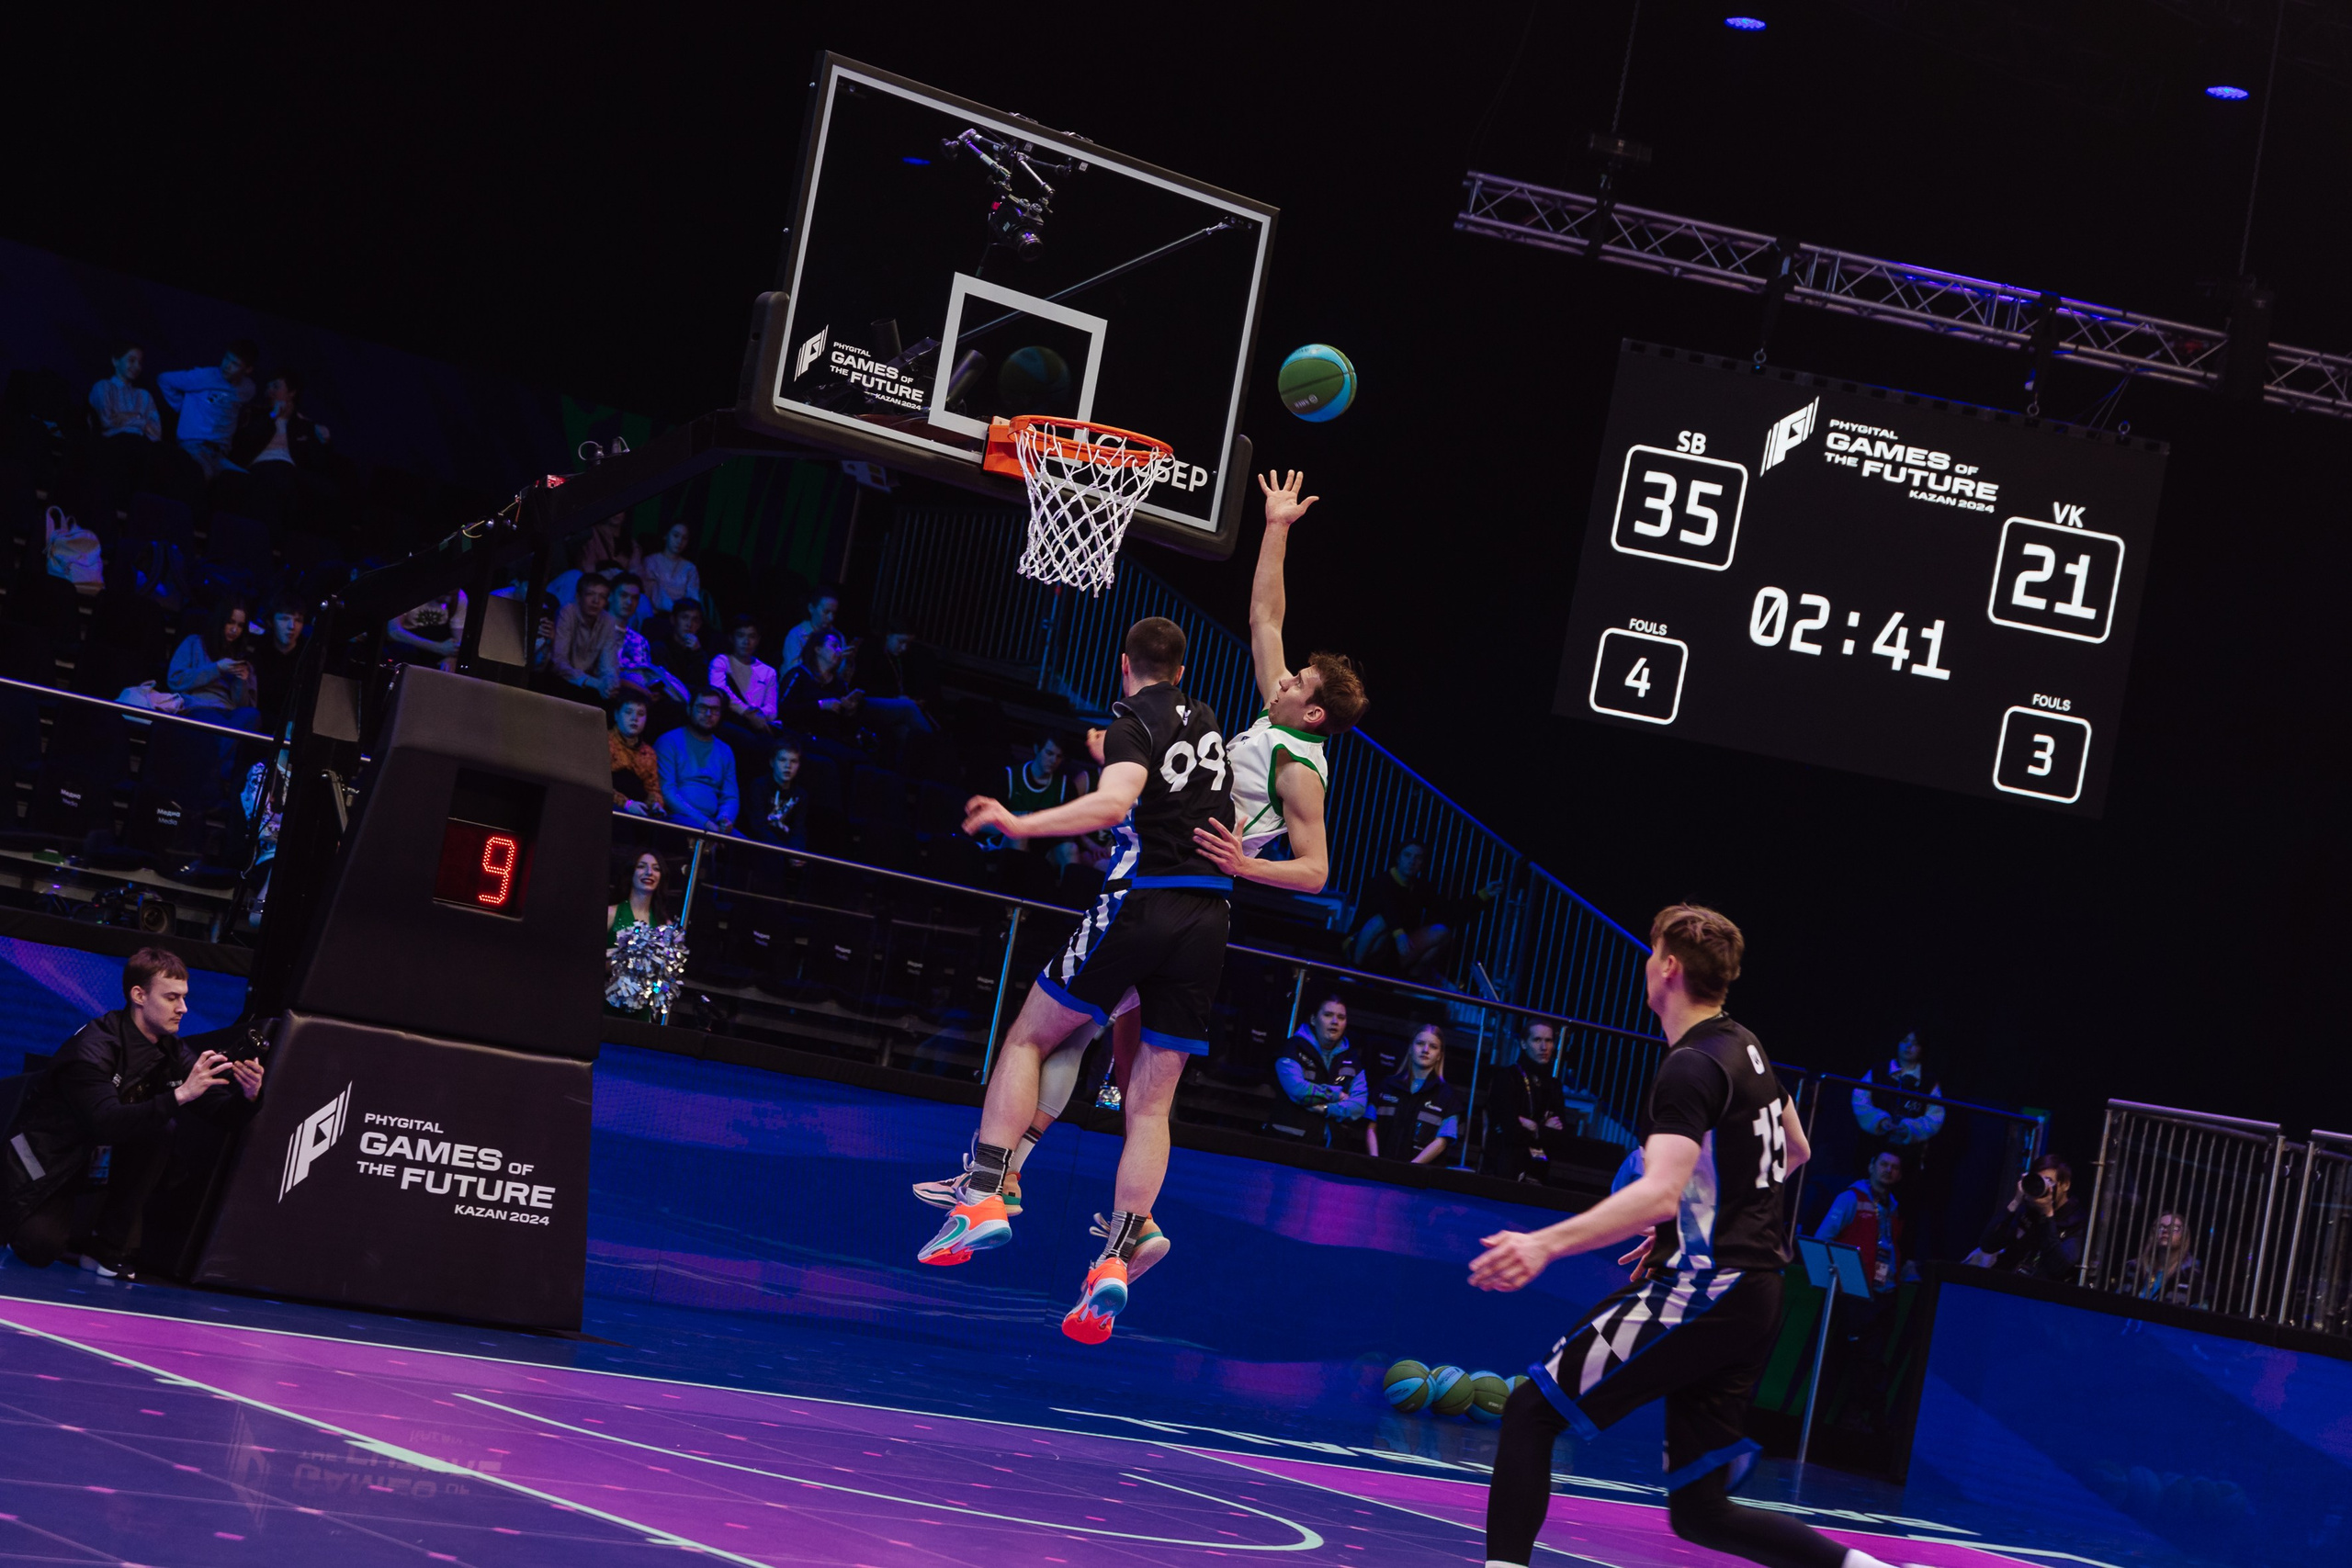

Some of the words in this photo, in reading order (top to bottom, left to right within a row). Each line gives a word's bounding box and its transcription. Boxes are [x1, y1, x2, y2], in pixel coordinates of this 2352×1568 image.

[831, 350, 899, 380] GAMES
[900, 375, 914, 384] OF
[832, 341, 872, 357] PHYGITAL
[830, 365, 850, 377] THE
[850, 370, 924, 403] FUTURE
[875, 393, 901, 405] KAZAN
[900, 400, 922, 411] 2024
[1676, 430, 1707, 456] SB
[1829, 418, 1899, 440] PHYGITAL
[1826, 432, 1951, 470] GAMES
[1954, 463, 1979, 476] OF
[1824, 451, 1860, 468] THE
[1861, 459, 1999, 502] FUTURE
[1634, 470, 1724, 547] 35
[1908, 489, 1957, 506] KAZAN
[1957, 499, 1995, 513] 2024
[2052, 501, 2086, 529] VK
[2011, 542, 2097, 620] 21
[1628, 617, 1668, 637] FOULS
[1749, 586, 1951, 681] 02:41
[1624, 657, 1651, 698] 4
[2032, 693, 2072, 712] FOULS
[1159, 730, 1227, 793] 99
[2027, 733, 2055, 776] 3
[478, 835, 516, 905] 9
[364, 1112, 444, 1134] PHYGITAL
[359, 1131, 503, 1171] GAMES
[507, 1162, 535, 1176] OF
[1752, 1097, 1788, 1190] 15
[356, 1160, 397, 1178] THE
[400, 1167, 556, 1210] FUTURE
[454, 1204, 507, 1221] KAZAN
[509, 1212, 550, 1226] 2024
